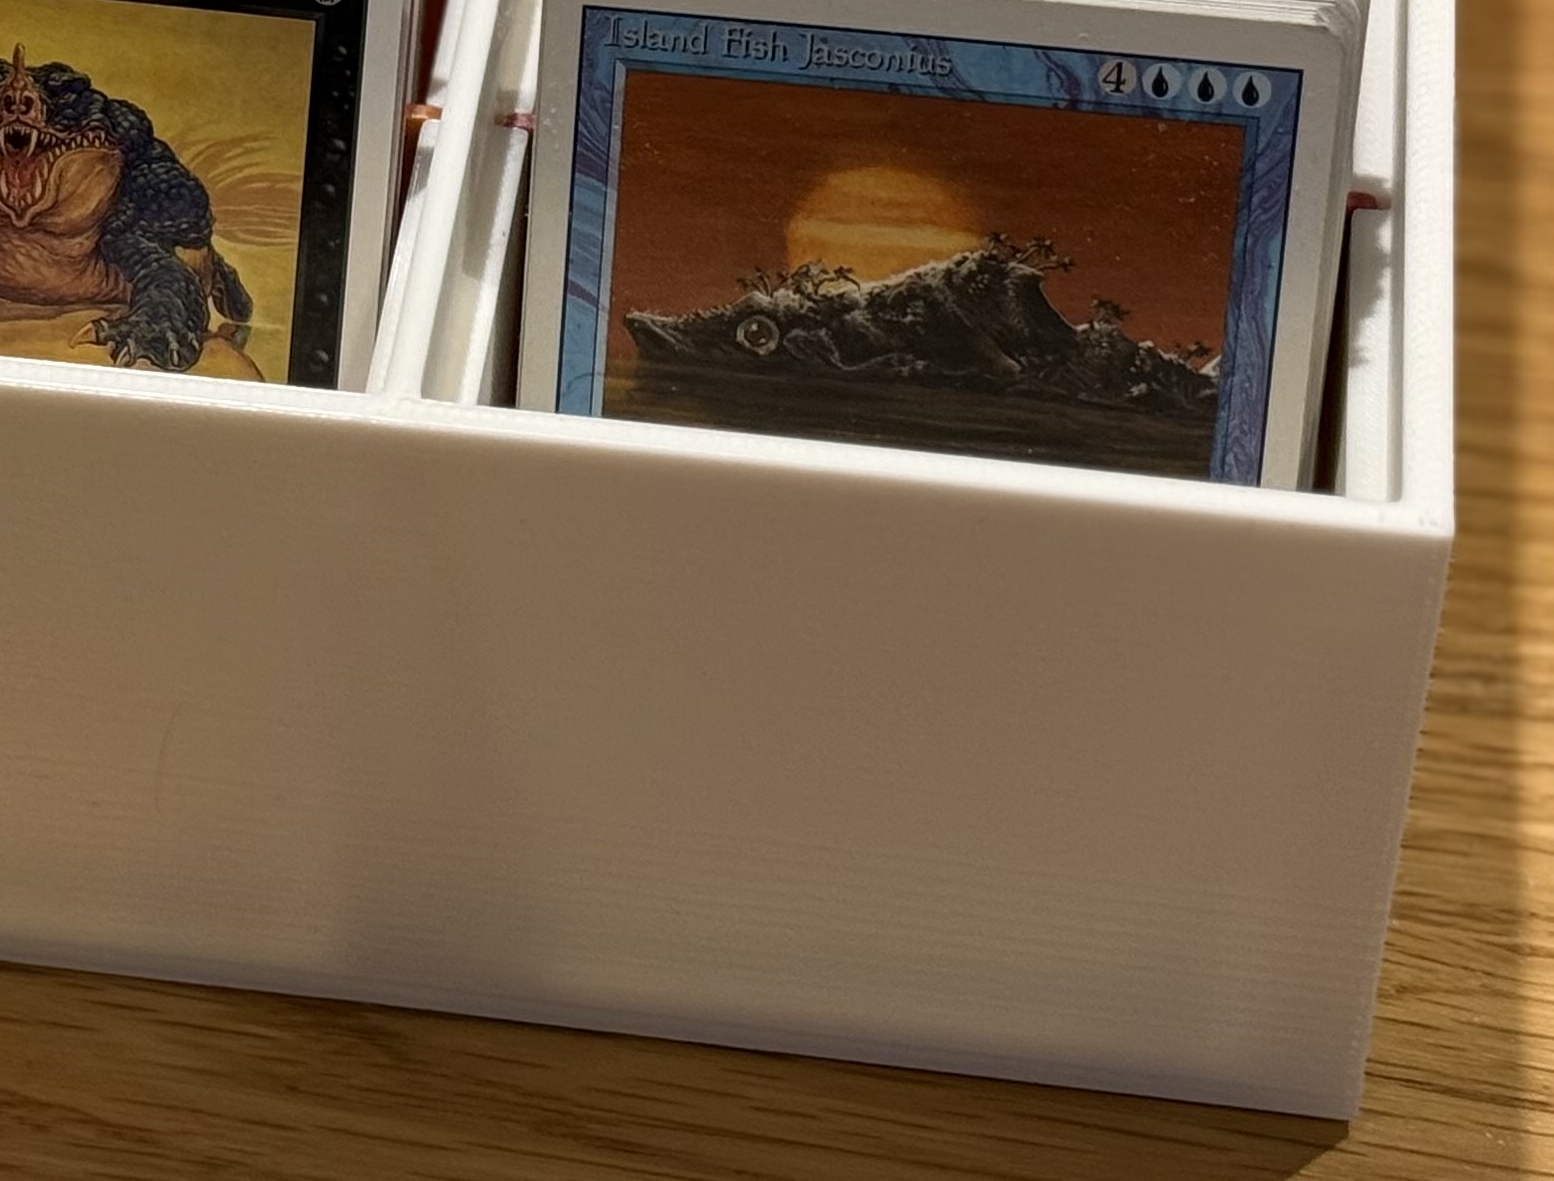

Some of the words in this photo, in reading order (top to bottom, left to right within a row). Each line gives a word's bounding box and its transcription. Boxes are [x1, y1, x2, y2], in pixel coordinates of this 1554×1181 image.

[604, 15, 709, 58] Island
[720, 25, 790, 63] Fish
[798, 31, 954, 77] Jasconius
[1101, 60, 1127, 94] 4
